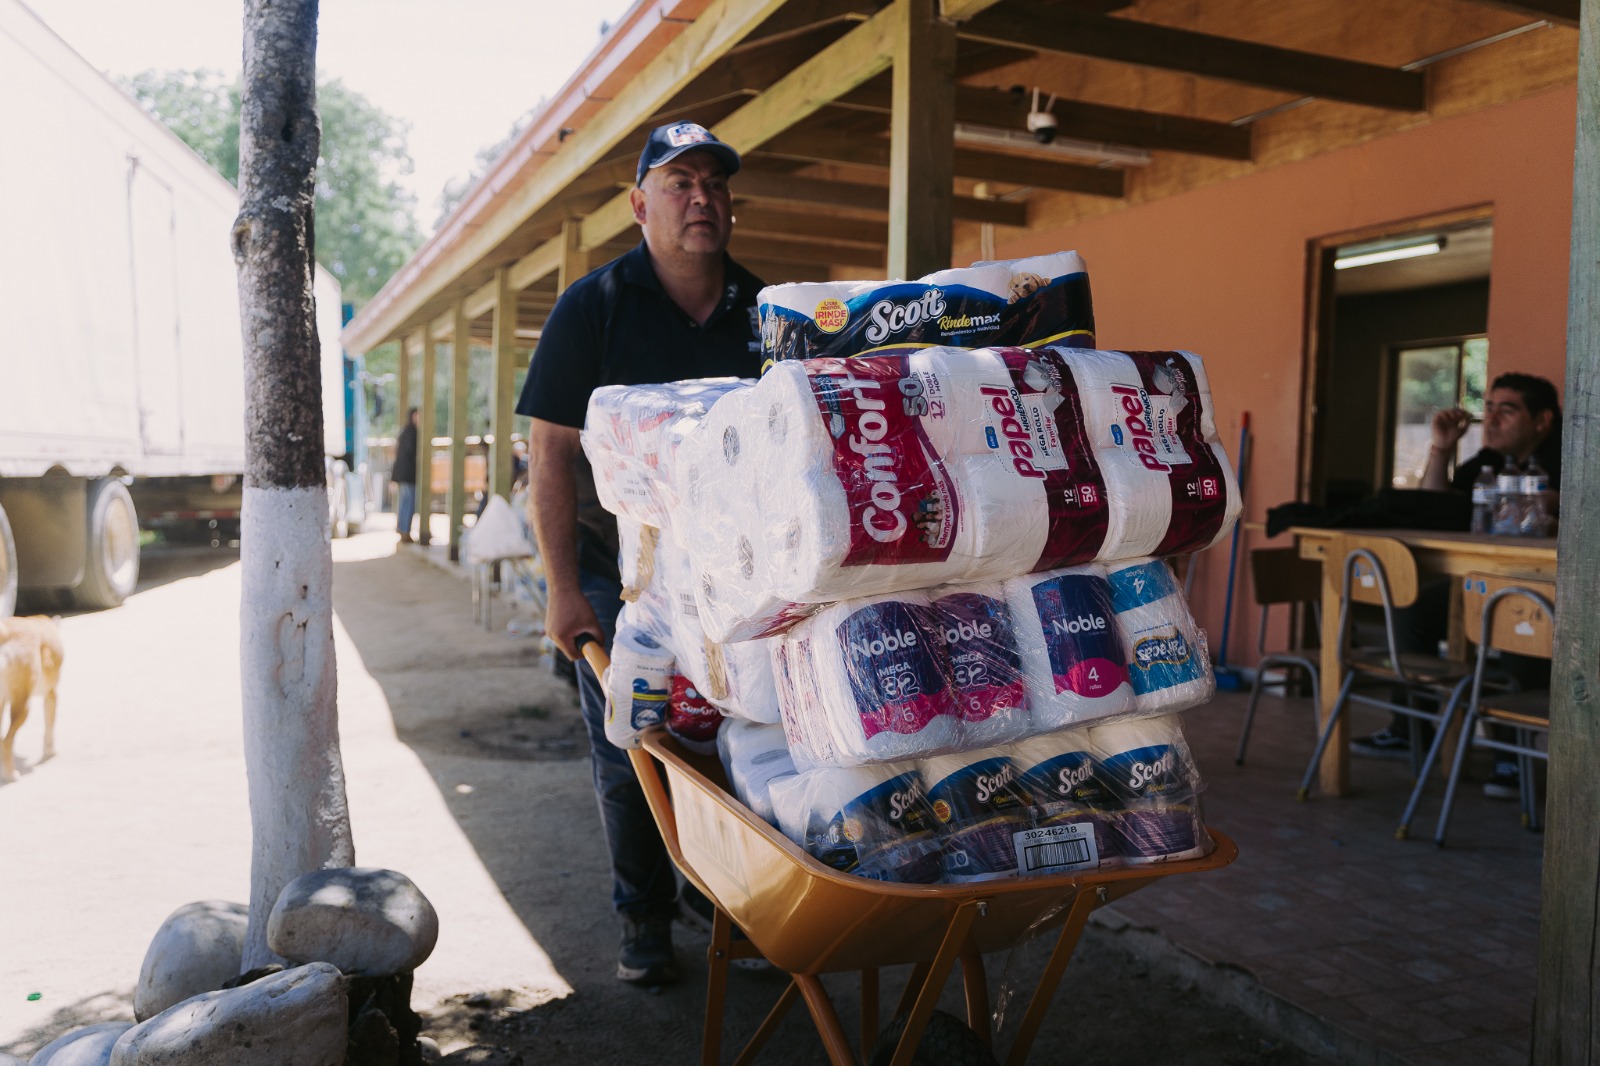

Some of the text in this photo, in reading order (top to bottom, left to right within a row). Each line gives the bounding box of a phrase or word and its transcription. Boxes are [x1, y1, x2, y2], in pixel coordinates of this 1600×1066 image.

[815, 309, 847, 320] ¡RINDE
[867, 289, 945, 343] Scott
[937, 312, 1001, 331] Rindemax
[940, 329, 972, 337] Rendimiento
[923, 371, 935, 395] DOBLE
[931, 373, 941, 392] HOJA
[898, 378, 928, 417] 50
[930, 400, 943, 419] 12
[1010, 389, 1030, 431] HIGIÉNICO
[1140, 389, 1154, 431] HIGIÉNICO
[980, 386, 1046, 478] papel
[1032, 407, 1050, 456] MEGA ROLLO
[1045, 415, 1056, 448] Familiar
[1111, 386, 1171, 471] papel
[1157, 408, 1173, 453] MEGA ROLLO
[838, 373, 907, 543] Confort
[1064, 489, 1074, 504] 12
[1082, 486, 1093, 503] 50
[1187, 483, 1196, 497] 12
[1203, 479, 1214, 496] 50
[941, 494, 951, 513] rinde
[938, 514, 953, 546] Siempre
[1133, 578, 1145, 595] 4
[1052, 613, 1106, 636] Noble
[851, 629, 917, 661] Noble
[879, 661, 911, 677] MEGA
[952, 652, 982, 665] MEGA
[881, 672, 919, 700] 32
[953, 662, 990, 688] 32
[1088, 666, 1100, 682] 4
[969, 696, 981, 711] 6
[1059, 758, 1094, 794] Scott
[1129, 751, 1175, 789] Scott
[977, 763, 1013, 802] Scott
[1024, 825, 1078, 841] 30246218
